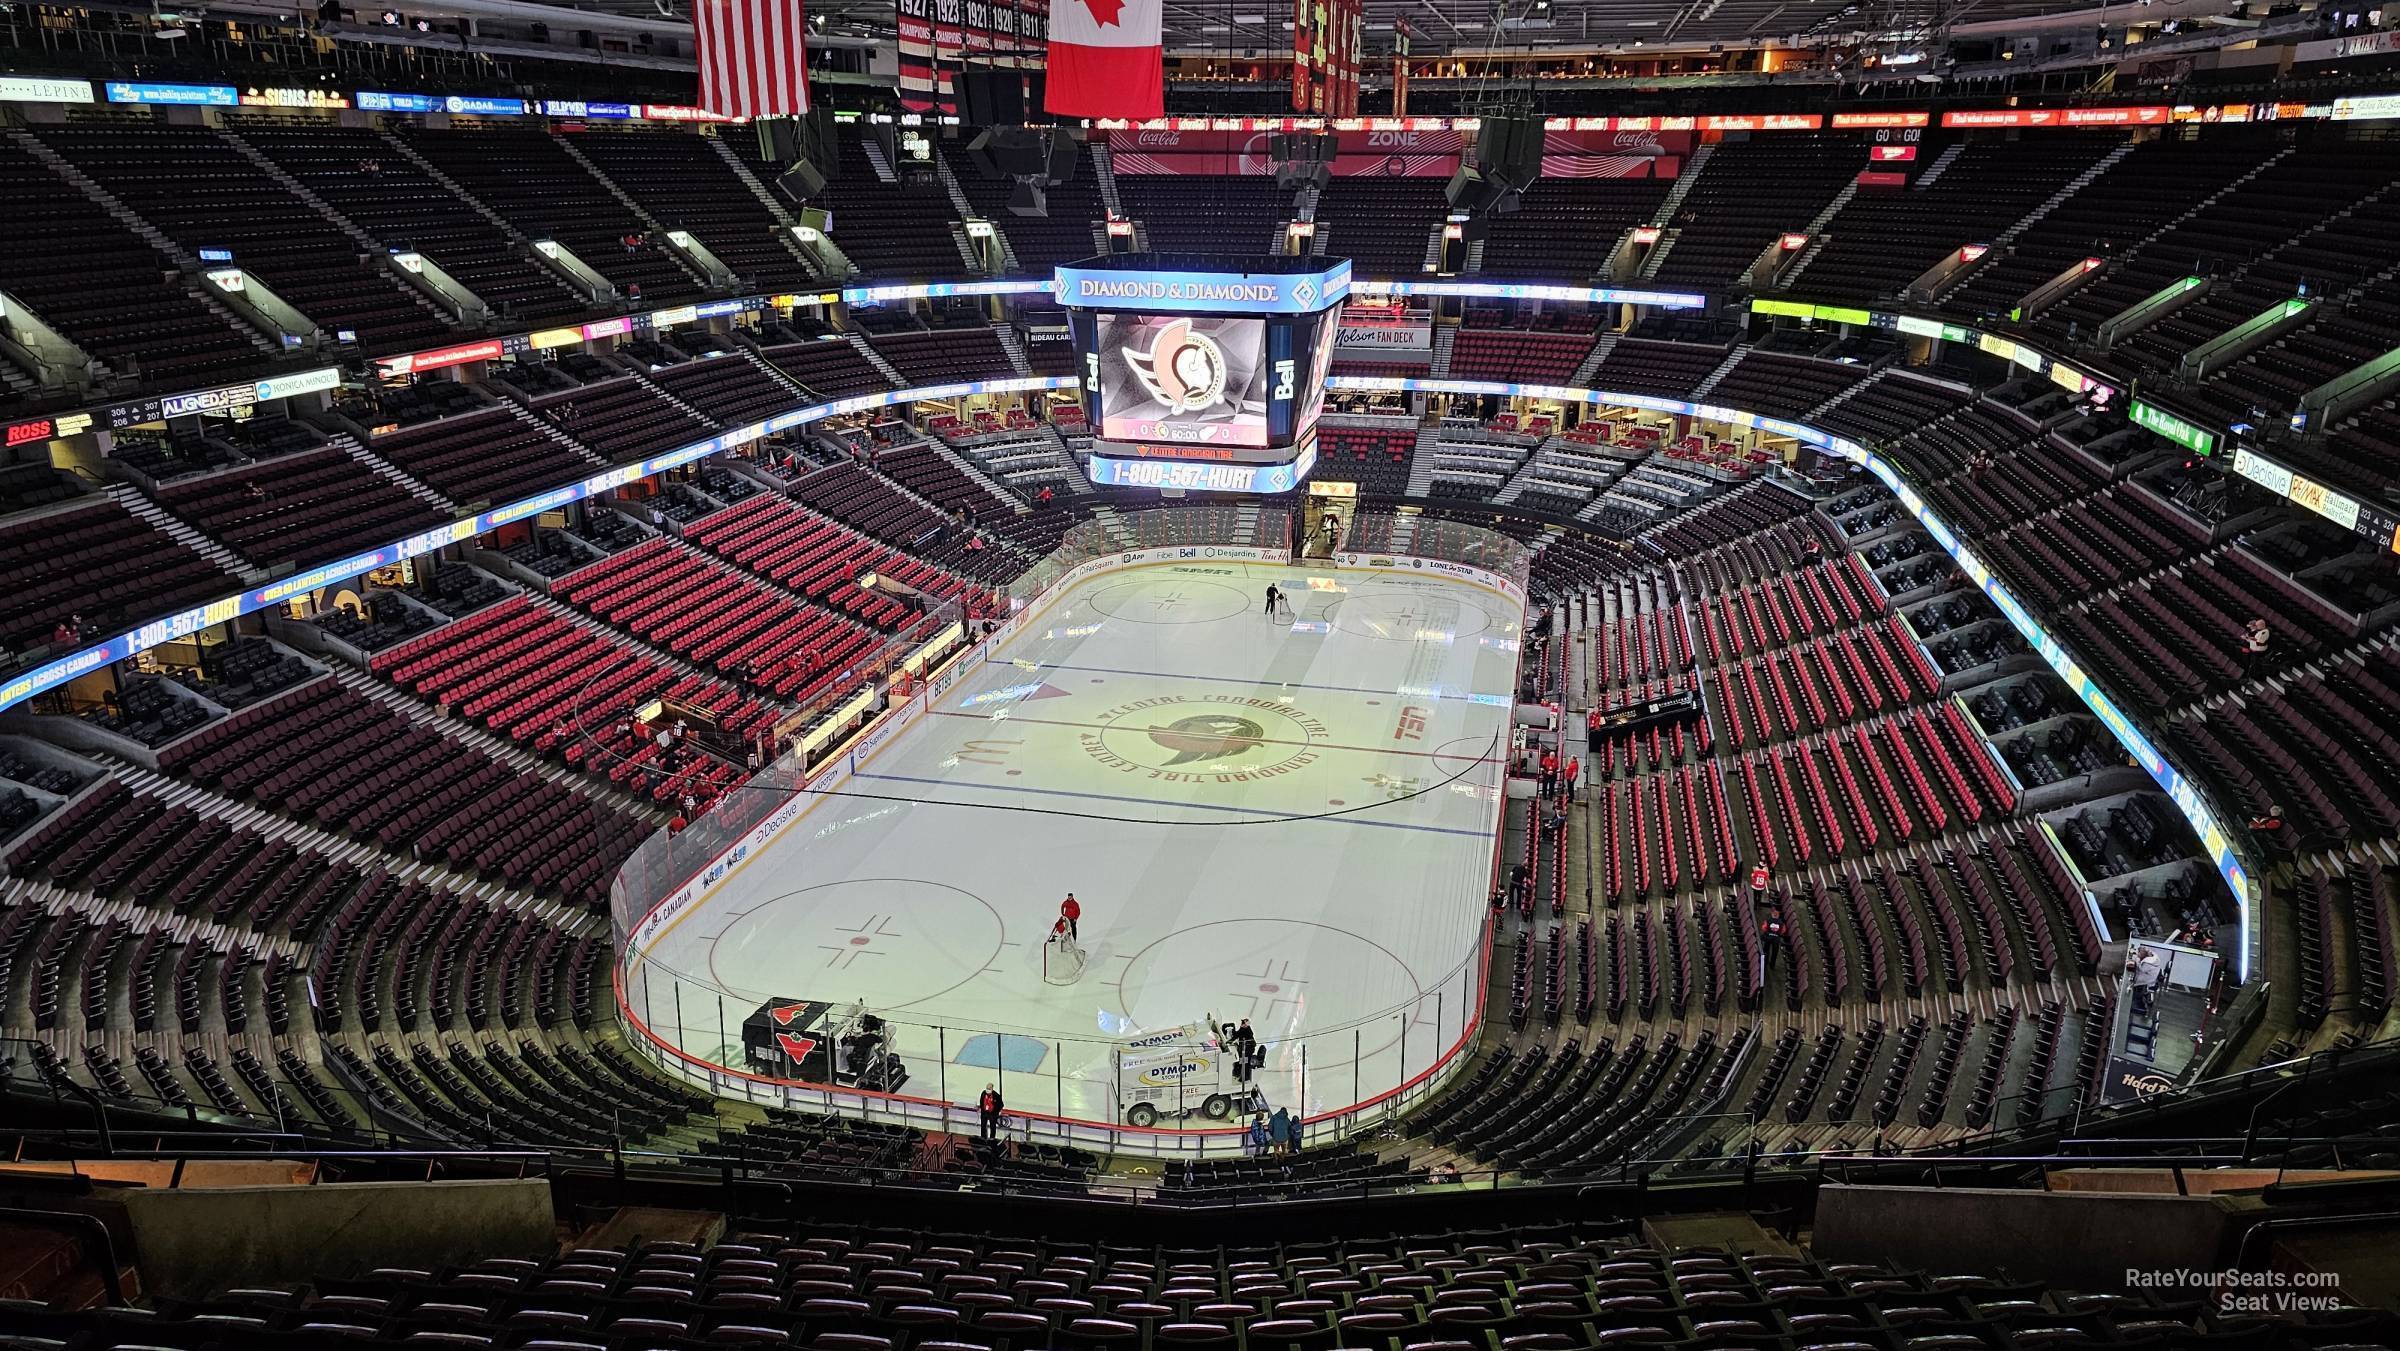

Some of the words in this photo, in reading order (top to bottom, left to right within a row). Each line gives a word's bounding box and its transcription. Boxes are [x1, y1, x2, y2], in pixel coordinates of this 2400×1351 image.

[900, 0, 927, 17] 1927
[935, 0, 960, 24] 1923
[966, 1, 988, 28] 1921
[992, 6, 1013, 33] 1920
[1021, 12, 1039, 38] 1911
[935, 30, 963, 45] CHAMPIONS
[33, 83, 92, 99] LÉPINE
[264, 88, 326, 107] SIGNS.CA
[1708, 116, 1723, 129] Tim
[1763, 115, 1779, 129] Tim
[1952, 113, 1967, 123] Find
[1367, 131, 1420, 146] ZONE
[1875, 129, 1890, 142] GO
[1903, 128, 1921, 142] GO!
[1080, 279, 1166, 298] DIAMOND
[1168, 281, 1181, 297] &
[1183, 283, 1272, 302] DIAMOND
[1335, 327, 1375, 346] Molson
[1377, 331, 1392, 343] FAN
[1393, 331, 1414, 343] DECK
[1086, 352, 1100, 393] Bell
[1274, 359, 1296, 401] Bell
[273, 382, 303, 393] KONICA
[304, 373, 338, 387] MINOLTA
[111, 408, 127, 417] 306
[144, 402, 158, 411] 307
[146, 411, 161, 421] 207
[7, 420, 52, 442] ROSS
[1140, 425, 1148, 435] 0
[1171, 430, 1198, 440] 60:00
[1221, 428, 1230, 439] 0
[2147, 410, 2160, 426] The
[2158, 413, 2178, 434] Royal
[2177, 422, 2190, 441] Oak
[1216, 450, 1234, 460] TIRE
[1112, 462, 1256, 489] 1-800-567-HURT
[2245, 456, 2287, 493] Decisive
[2291, 477, 2325, 509] RE/MAX
[2324, 491, 2357, 516] Hallmark
[2360, 508, 2372, 521] 323
[2383, 519, 2396, 532] 324
[396, 516, 478, 560] 1-800-567-HURT
[2378, 534, 2391, 547] 224
[1179, 548, 1196, 558] Bell
[1217, 549, 1257, 558] Desjardins
[1261, 550, 1277, 561] Tim
[1430, 561, 1450, 570] LONE
[1457, 567, 1474, 576] STAR
[263, 588, 284, 602] OVER
[293, 573, 325, 592] LAWYERS
[325, 562, 352, 580] ACROSS
[126, 594, 242, 653] 1-800-567-HURT
[32, 663, 67, 689] ACROSS
[67, 650, 102, 675] CANADA
[934, 671, 952, 698] BET99
[1110, 694, 1186, 719] CENTRE
[1202, 693, 1305, 719] CANADIAN
[1303, 717, 1330, 739] TIRE
[869, 727, 889, 748] Supreme
[1147, 770, 1205, 783] TIRE
[1216, 751, 1321, 784] CANADIAN
[764, 803, 797, 838] Decisive
[663, 887, 692, 921] CANADIAN
[1130, 1030, 1184, 1048] DYMON
[1123, 1058, 1146, 1068] FREE
[1151, 1063, 1197, 1077] DYMON
[1182, 1087, 1200, 1095] FREE
[2121, 1073, 2158, 1093] Hard
